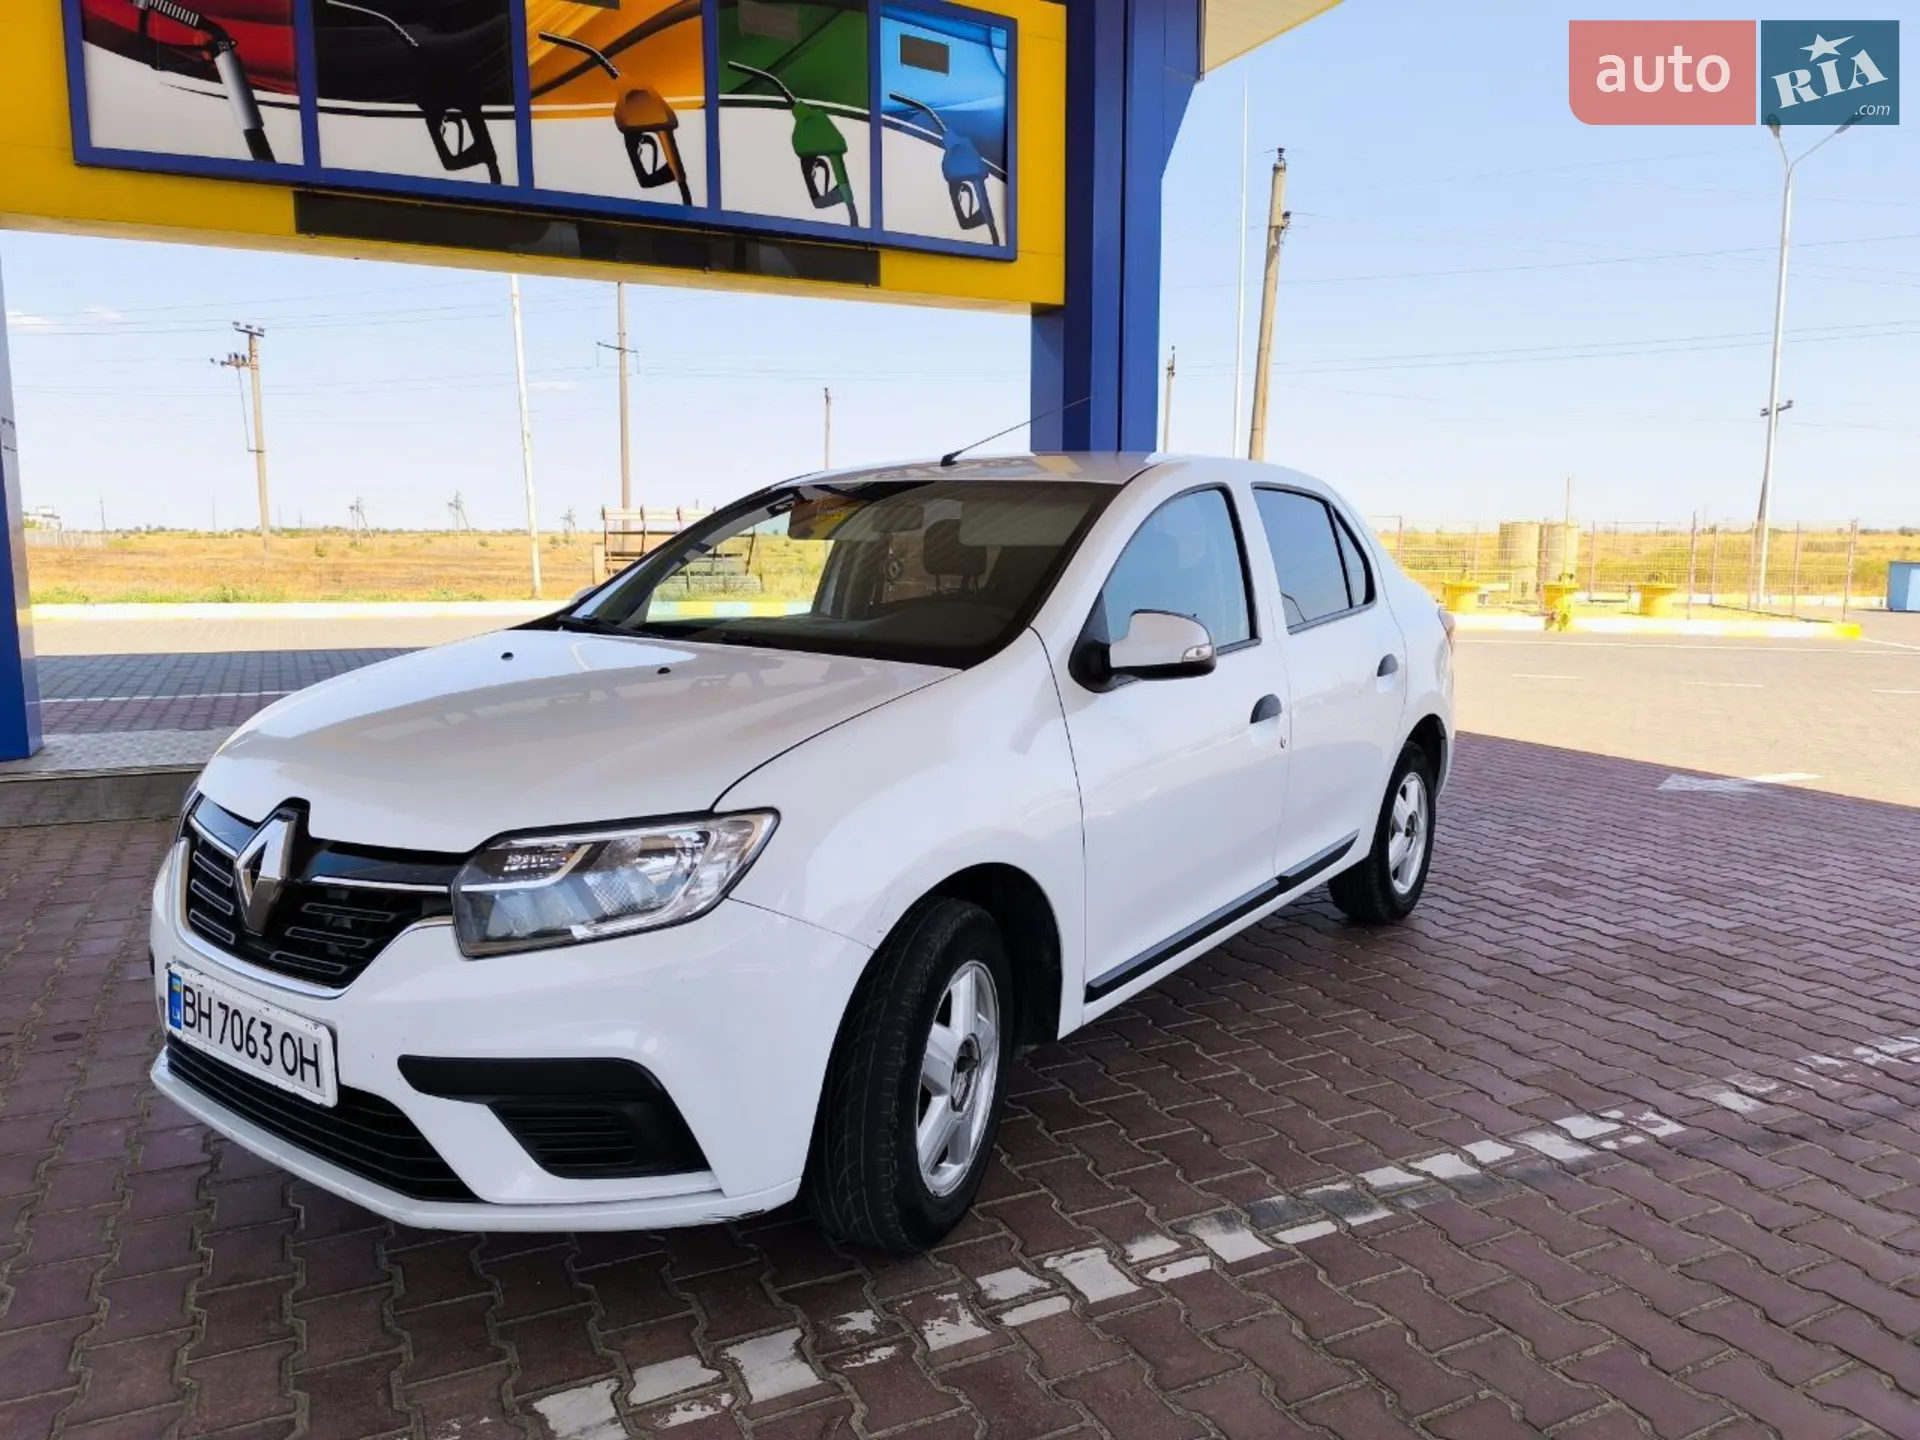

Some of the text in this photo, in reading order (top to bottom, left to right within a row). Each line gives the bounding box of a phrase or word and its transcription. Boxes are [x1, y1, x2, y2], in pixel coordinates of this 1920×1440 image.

[183, 984, 320, 1088] BH 7063 OH
